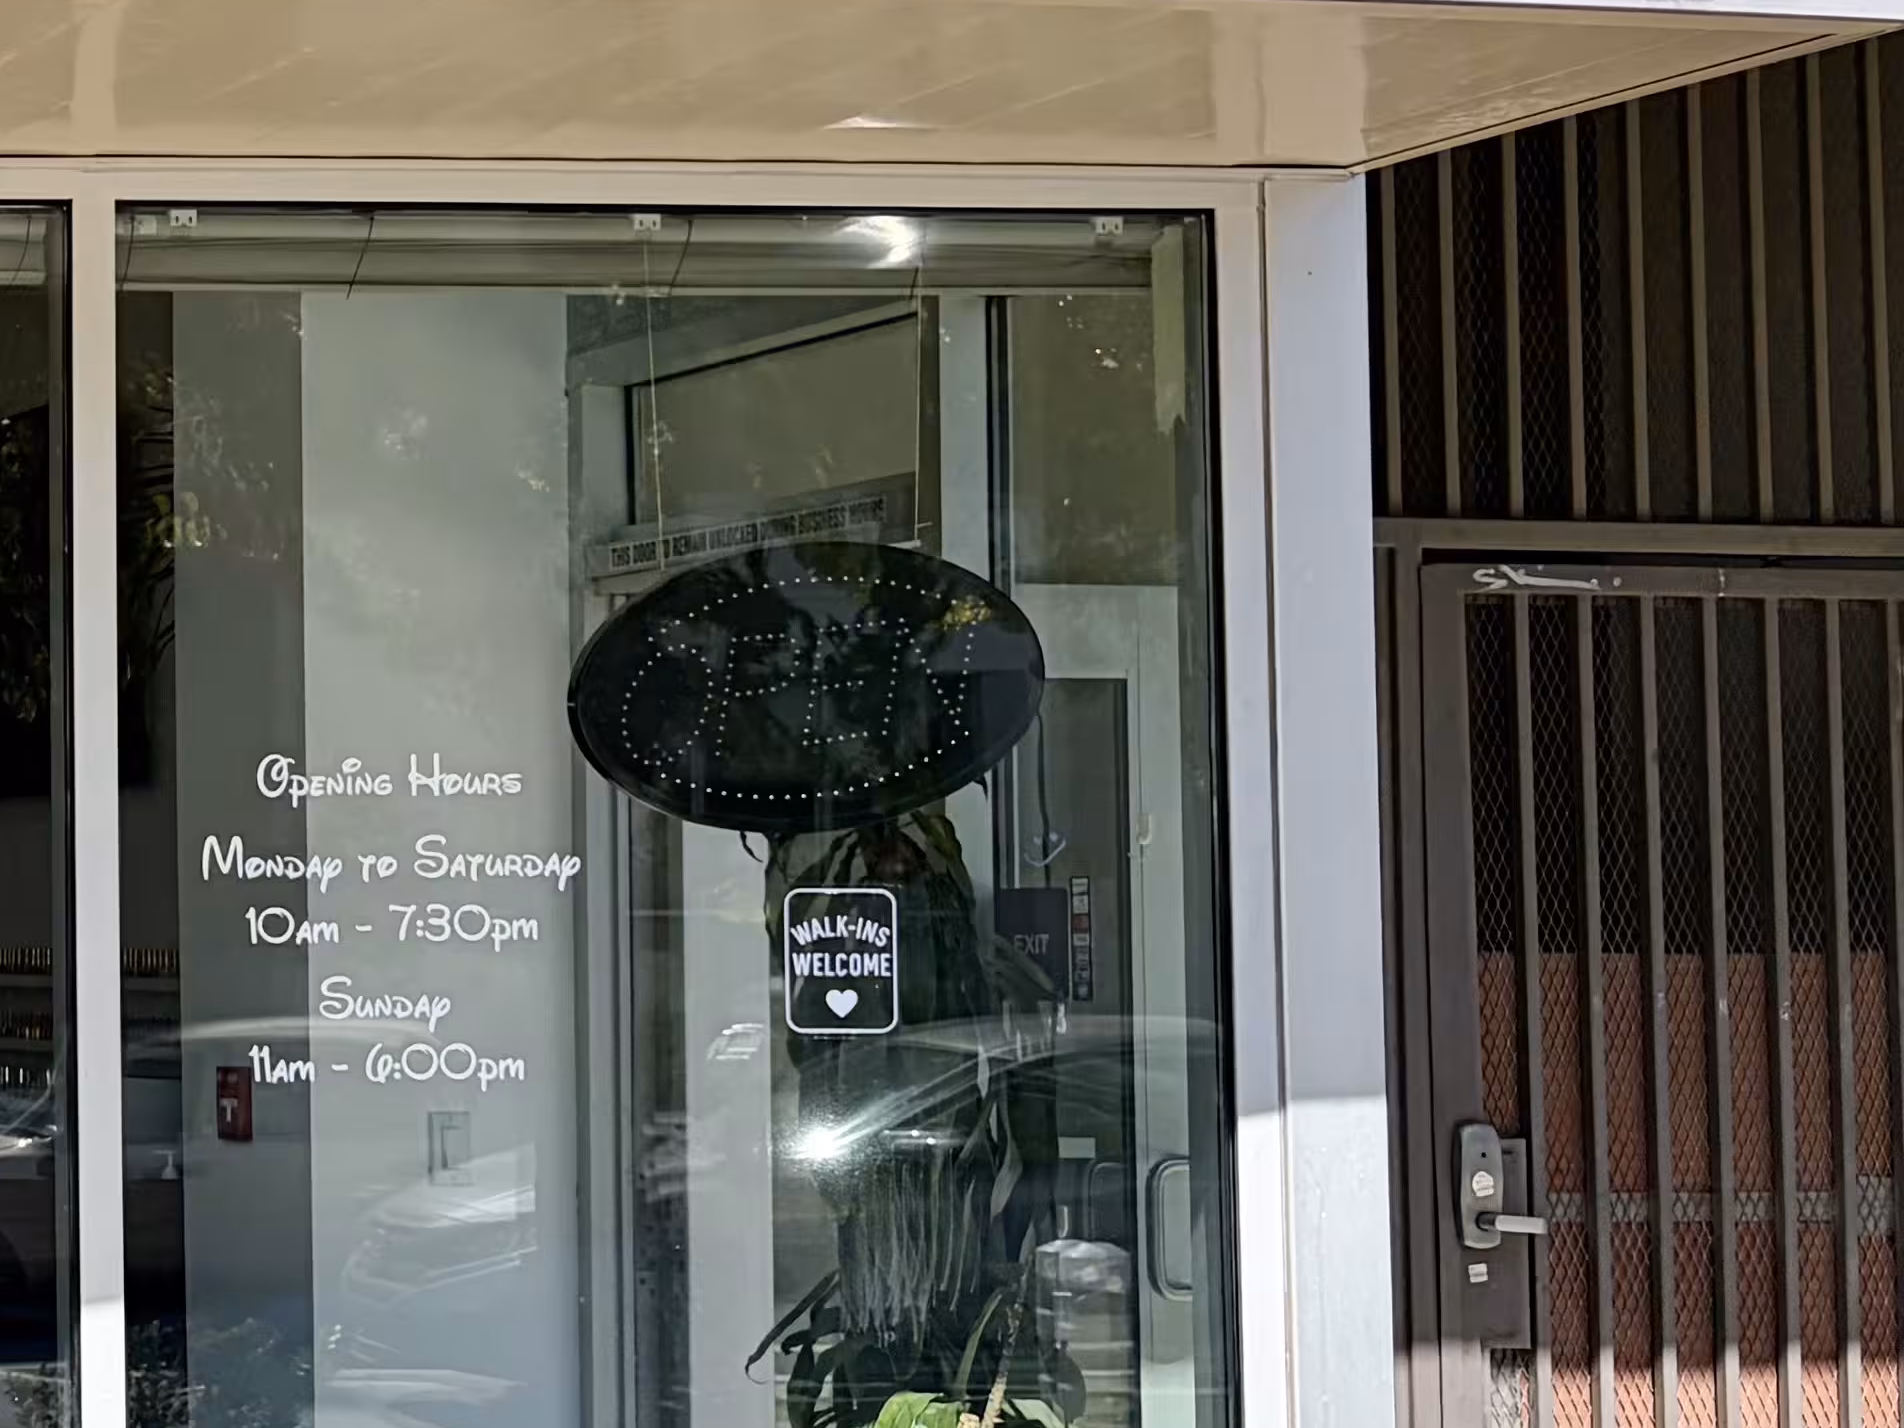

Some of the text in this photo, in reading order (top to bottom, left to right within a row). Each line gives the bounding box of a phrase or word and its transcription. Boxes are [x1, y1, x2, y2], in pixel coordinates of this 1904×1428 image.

[256, 752, 523, 808] Opening Hours
[202, 833, 581, 894] Monday to Saturday
[245, 906, 339, 945] 10am
[388, 903, 539, 953] 7:30pm
[790, 915, 891, 947] WALK-INS
[792, 952, 892, 978] WELCOME
[319, 975, 451, 1033] Sunday
[248, 1044, 316, 1084] 11am
[364, 1042, 525, 1092] 6:00pm
